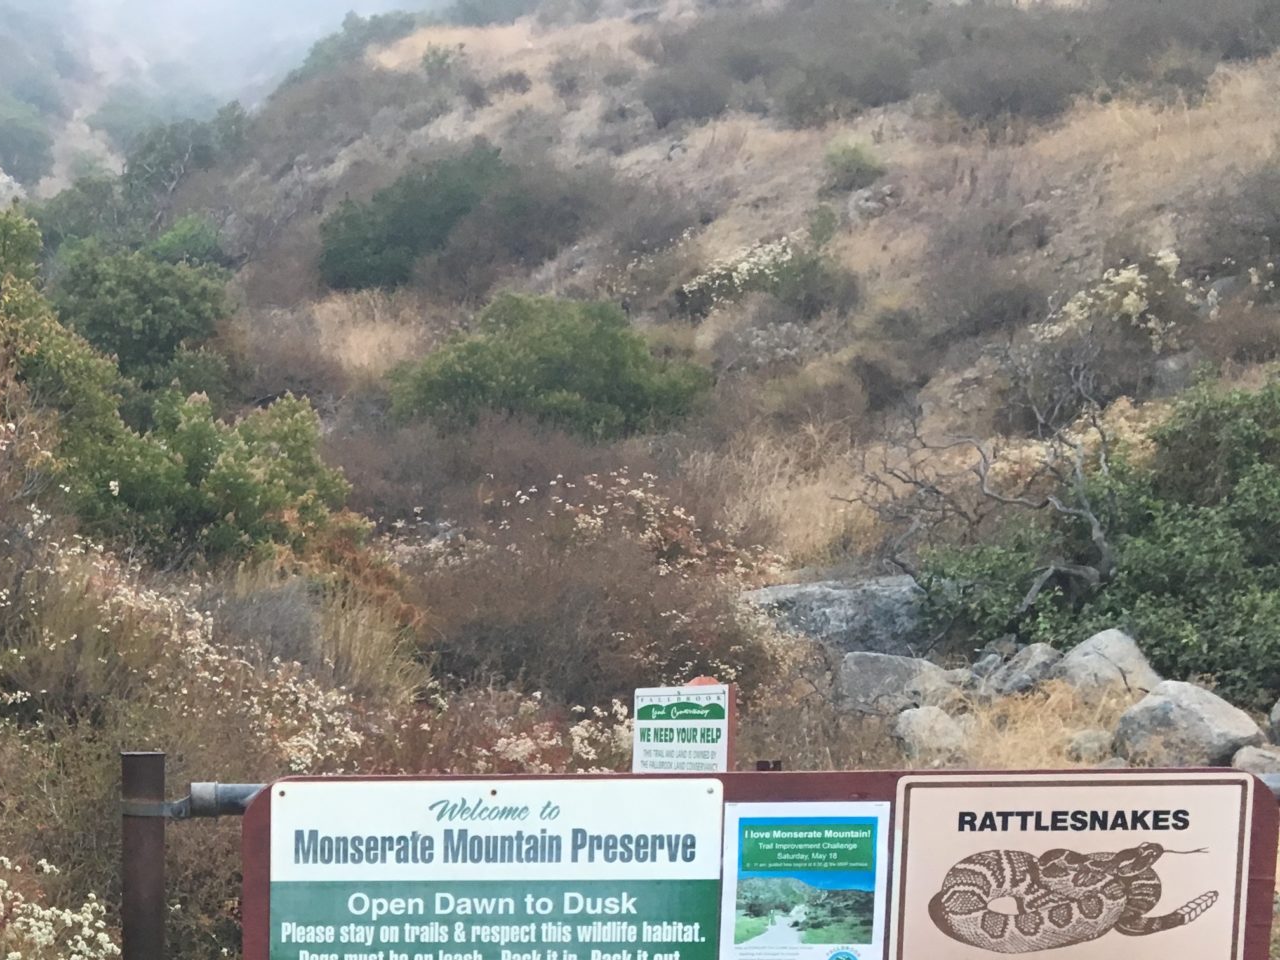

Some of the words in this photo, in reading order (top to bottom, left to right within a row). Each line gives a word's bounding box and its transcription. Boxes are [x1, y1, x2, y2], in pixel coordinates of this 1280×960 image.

[639, 727, 651, 743] WE
[653, 727, 674, 743] NEED
[676, 727, 698, 744] YOUR
[699, 727, 722, 744] HELP
[428, 797, 530, 822] Welcome
[538, 800, 561, 821] to
[958, 809, 1190, 832] RATTLESNAKES
[750, 829, 770, 839] love
[772, 829, 823, 839] Monserate
[824, 829, 871, 839] Mountain!
[294, 829, 435, 865] Monserate
[442, 828, 562, 864] Mountain
[571, 828, 697, 864] Preserve
[758, 842, 773, 850] Trail
[775, 842, 821, 851] Improvement
[822, 841, 858, 851] Challenge
[811, 852, 827, 861] May
[348, 892, 425, 921] Open
[434, 892, 515, 916] Dawn
[524, 893, 553, 915] to
[563, 891, 638, 915] Dusk
[281, 921, 335, 944] Please
[340, 922, 375, 946] stay
[379, 925, 399, 943] on
[404, 921, 449, 944] trails
[453, 921, 467, 943] &
[471, 922, 536, 946] respect
[541, 921, 572, 943] this
[577, 921, 637, 943] wildlife
[642, 921, 706, 943] habitat.
